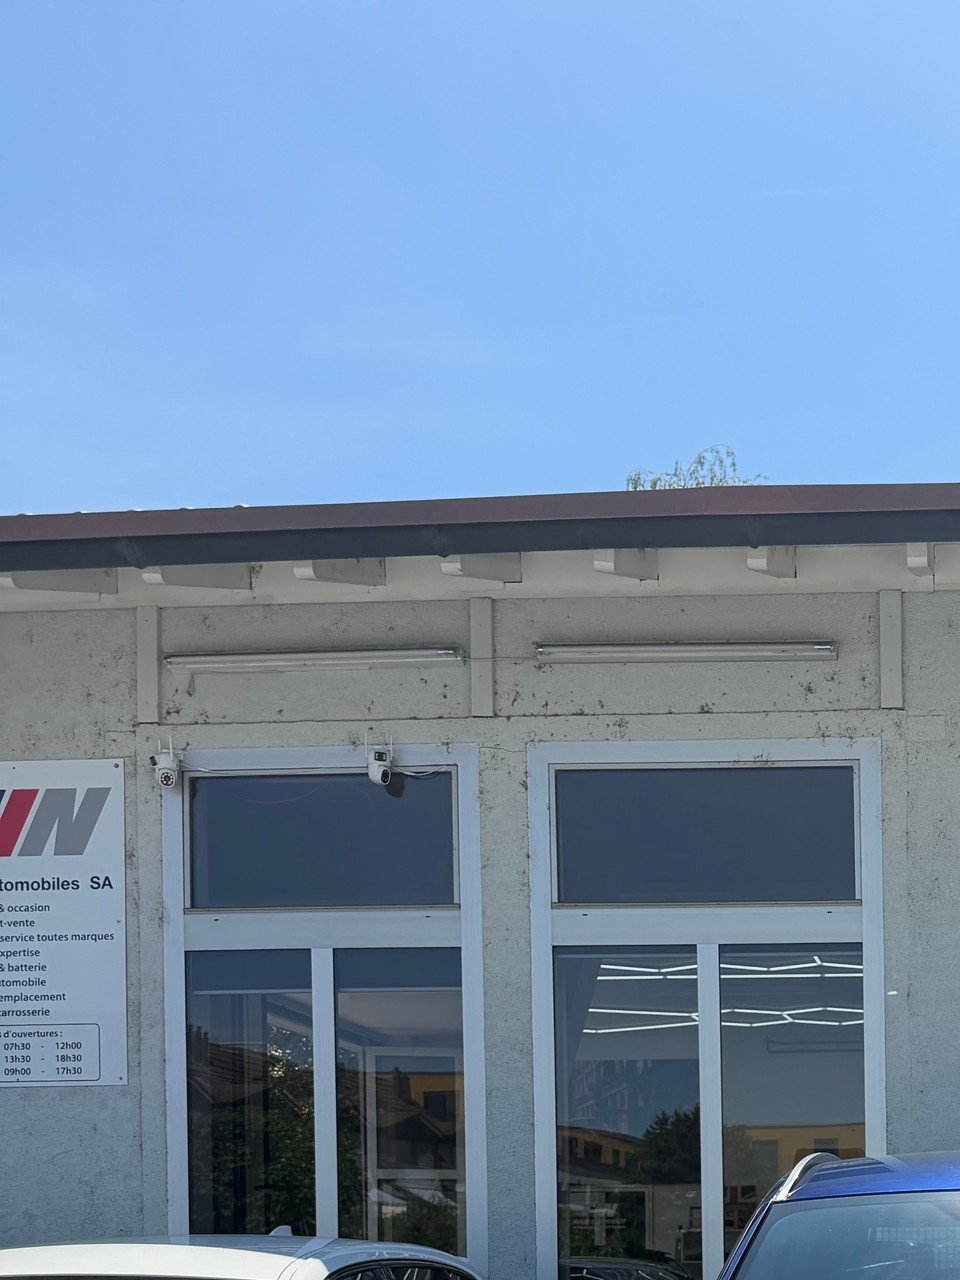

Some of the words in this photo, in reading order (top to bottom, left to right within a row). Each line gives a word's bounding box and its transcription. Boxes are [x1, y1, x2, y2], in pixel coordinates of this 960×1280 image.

[90, 875, 113, 889] SA
[7, 903, 50, 912] occasion
[0, 933, 35, 942] service
[37, 933, 69, 942] toutes
[71, 933, 114, 943] marques
[7, 962, 47, 972] batterie
[3, 1042, 31, 1051] 07h30
[55, 1041, 82, 1050] 12h00
[4, 1055, 31, 1063] 13h30
[55, 1054, 82, 1062] 18h30
[3, 1067, 31, 1076] 09h00
[56, 1066, 82, 1075] 17h30
